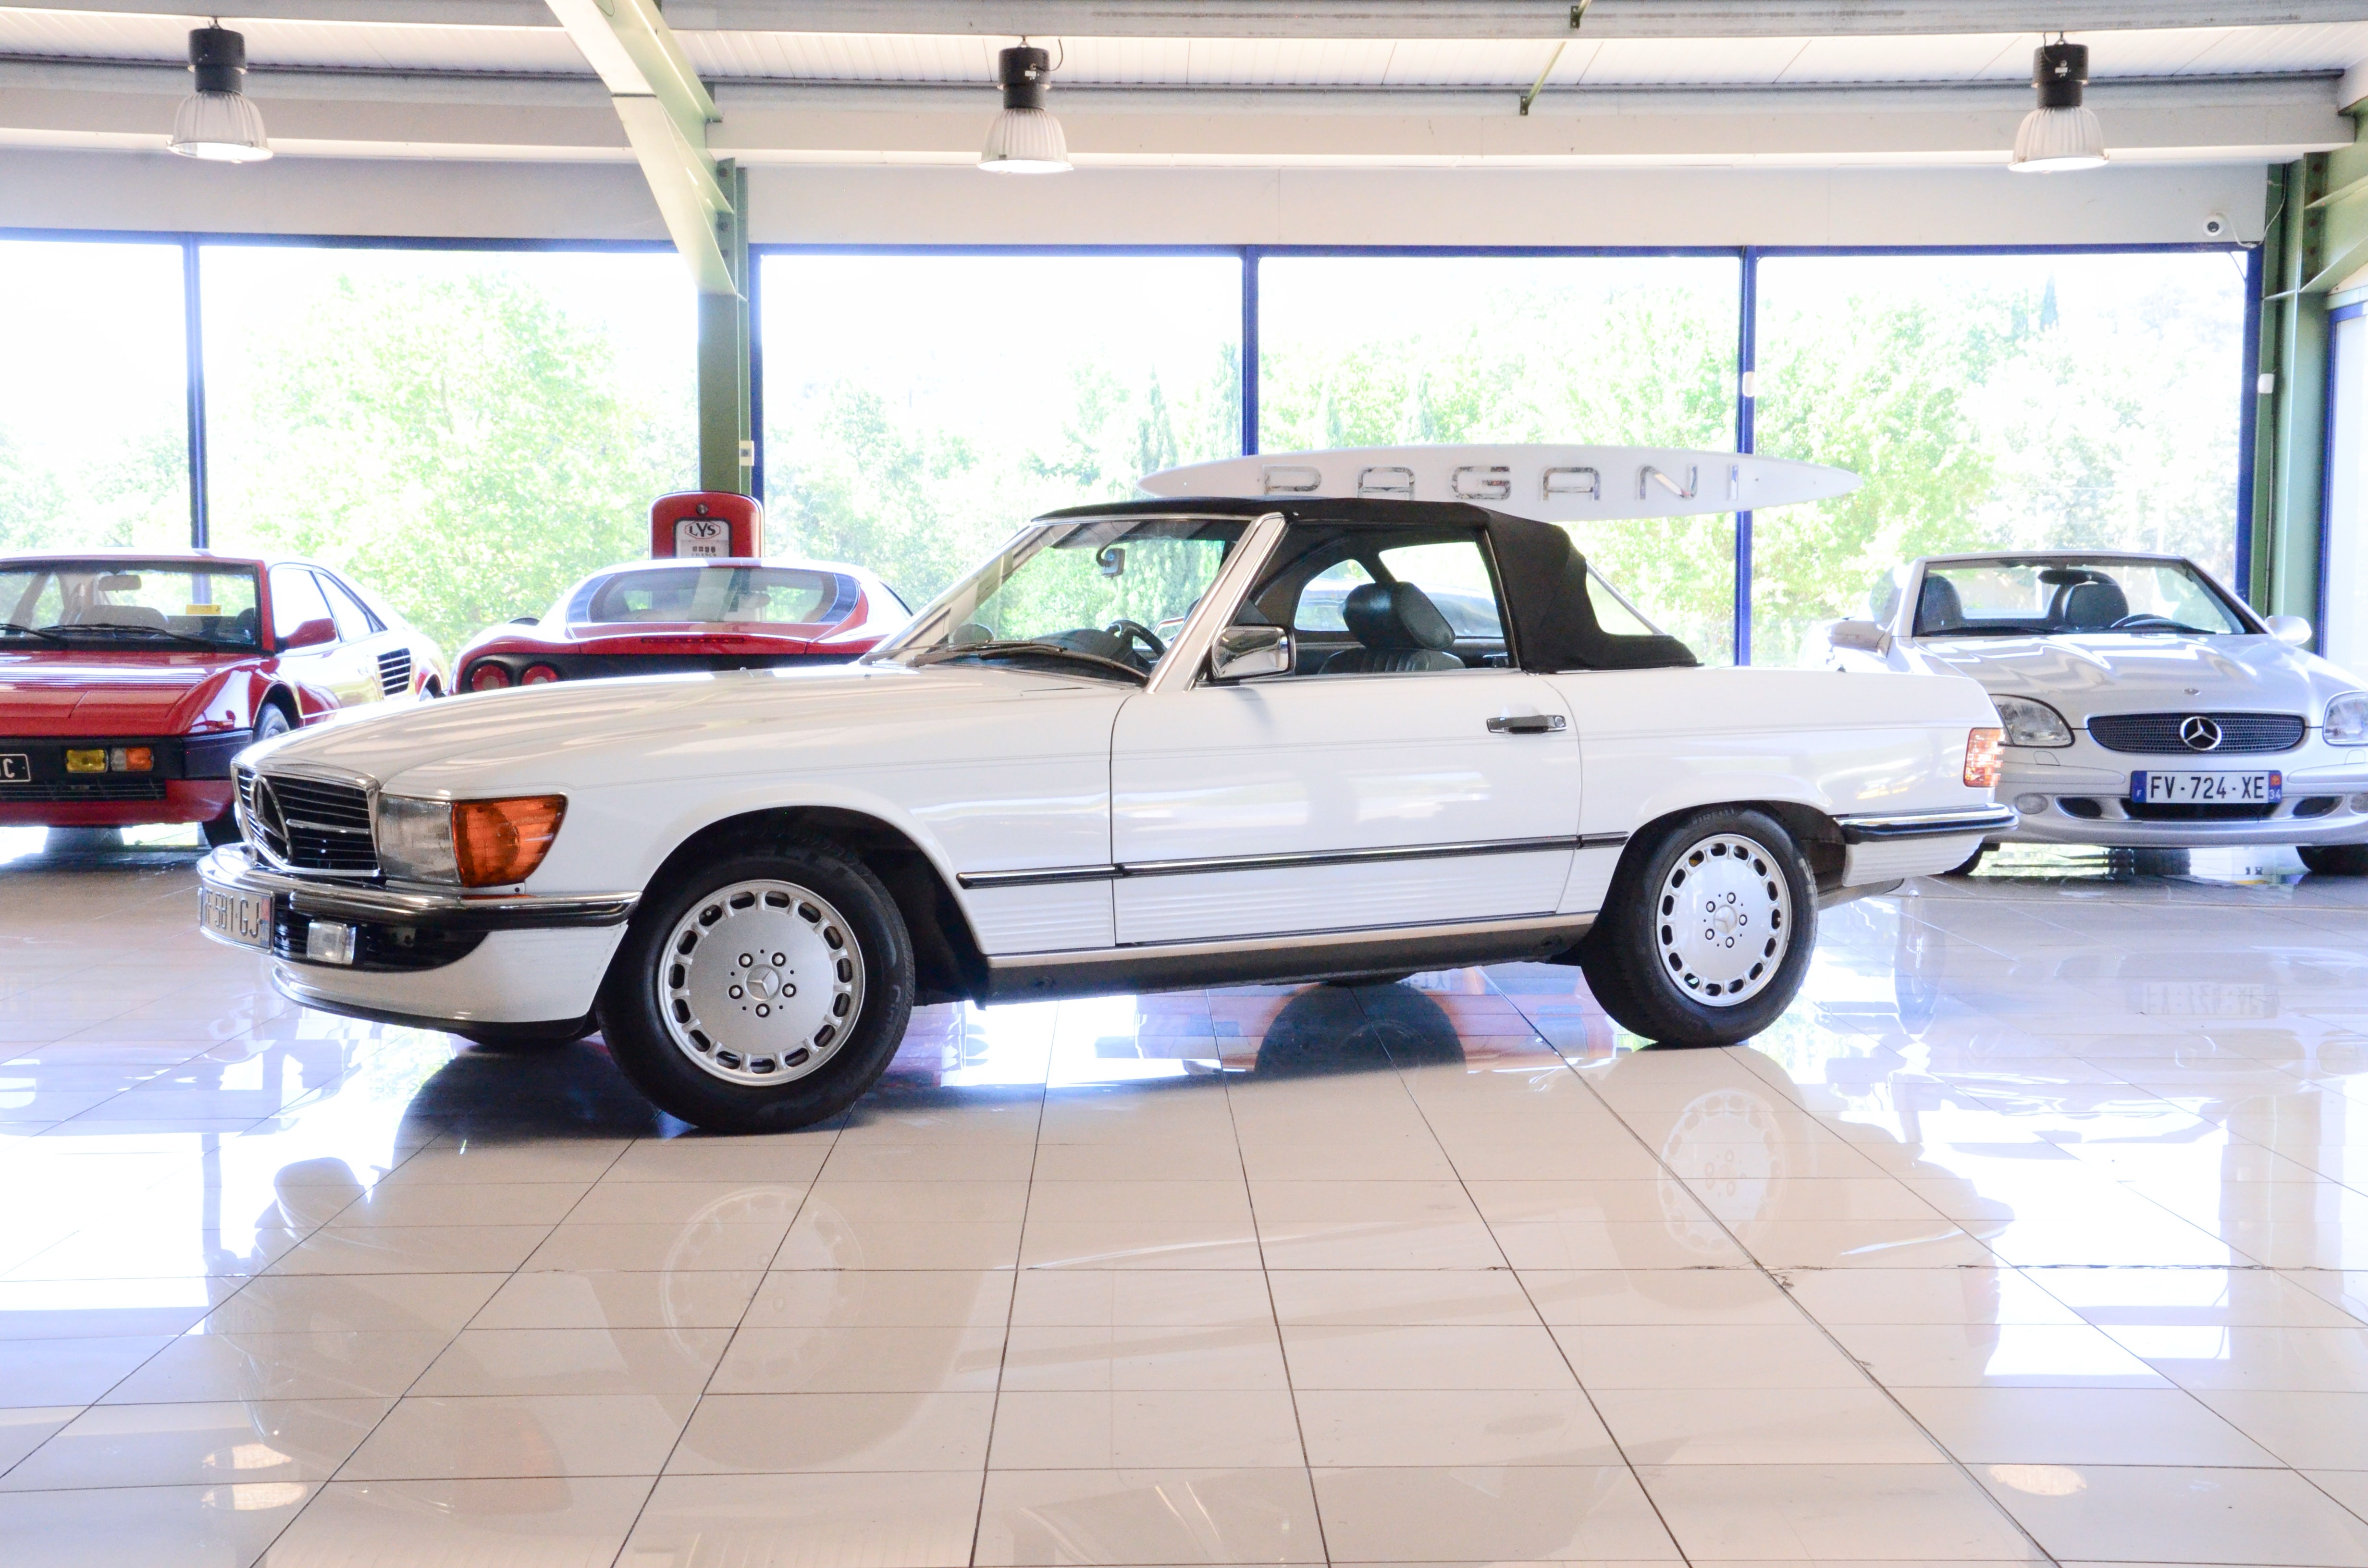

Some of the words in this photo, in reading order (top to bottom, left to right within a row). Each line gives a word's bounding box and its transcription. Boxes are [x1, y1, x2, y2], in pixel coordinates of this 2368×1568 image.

[1262, 464, 1739, 501] PAGANI
[689, 522, 716, 538] LYS
[2150, 776, 2265, 799] FV-724-XE
[2269, 789, 2281, 799] 34
